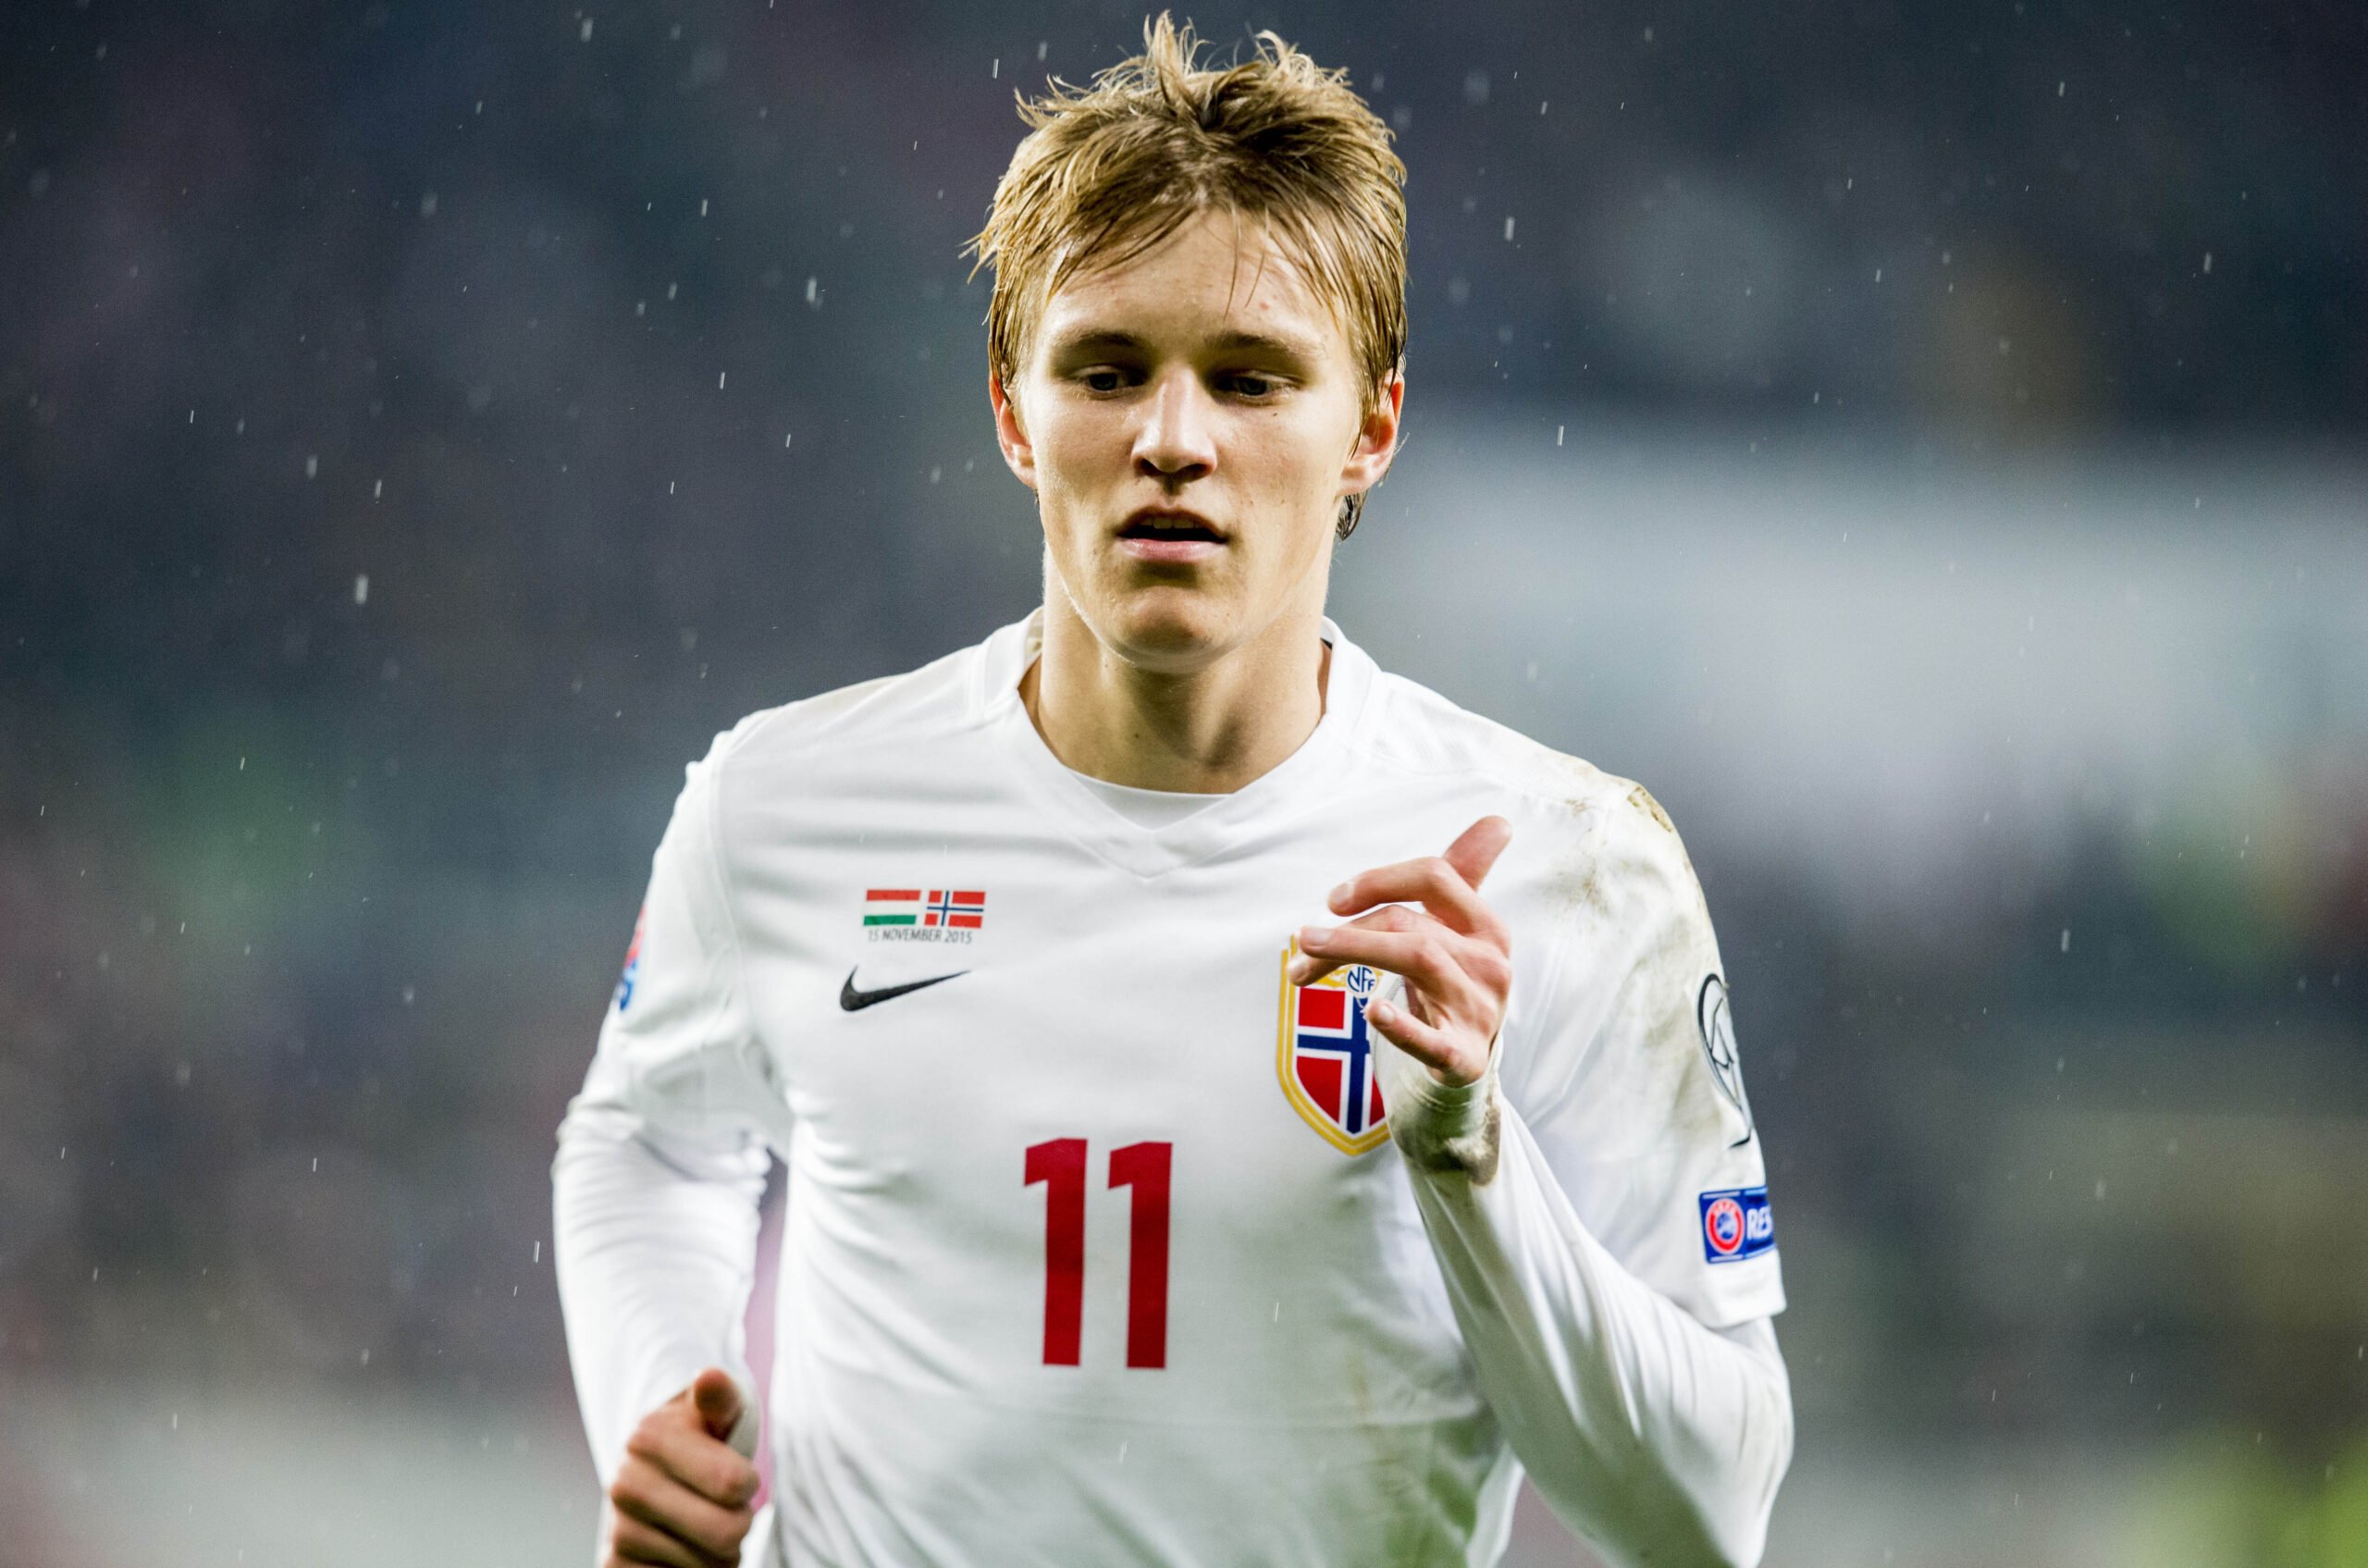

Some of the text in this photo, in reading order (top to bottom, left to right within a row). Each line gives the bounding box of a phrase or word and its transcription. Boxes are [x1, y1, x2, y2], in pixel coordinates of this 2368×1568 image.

[868, 928, 973, 945] 15 NOVEMBER 2015
[1347, 966, 1375, 993] NFF
[1024, 1138, 1173, 1369] 11
